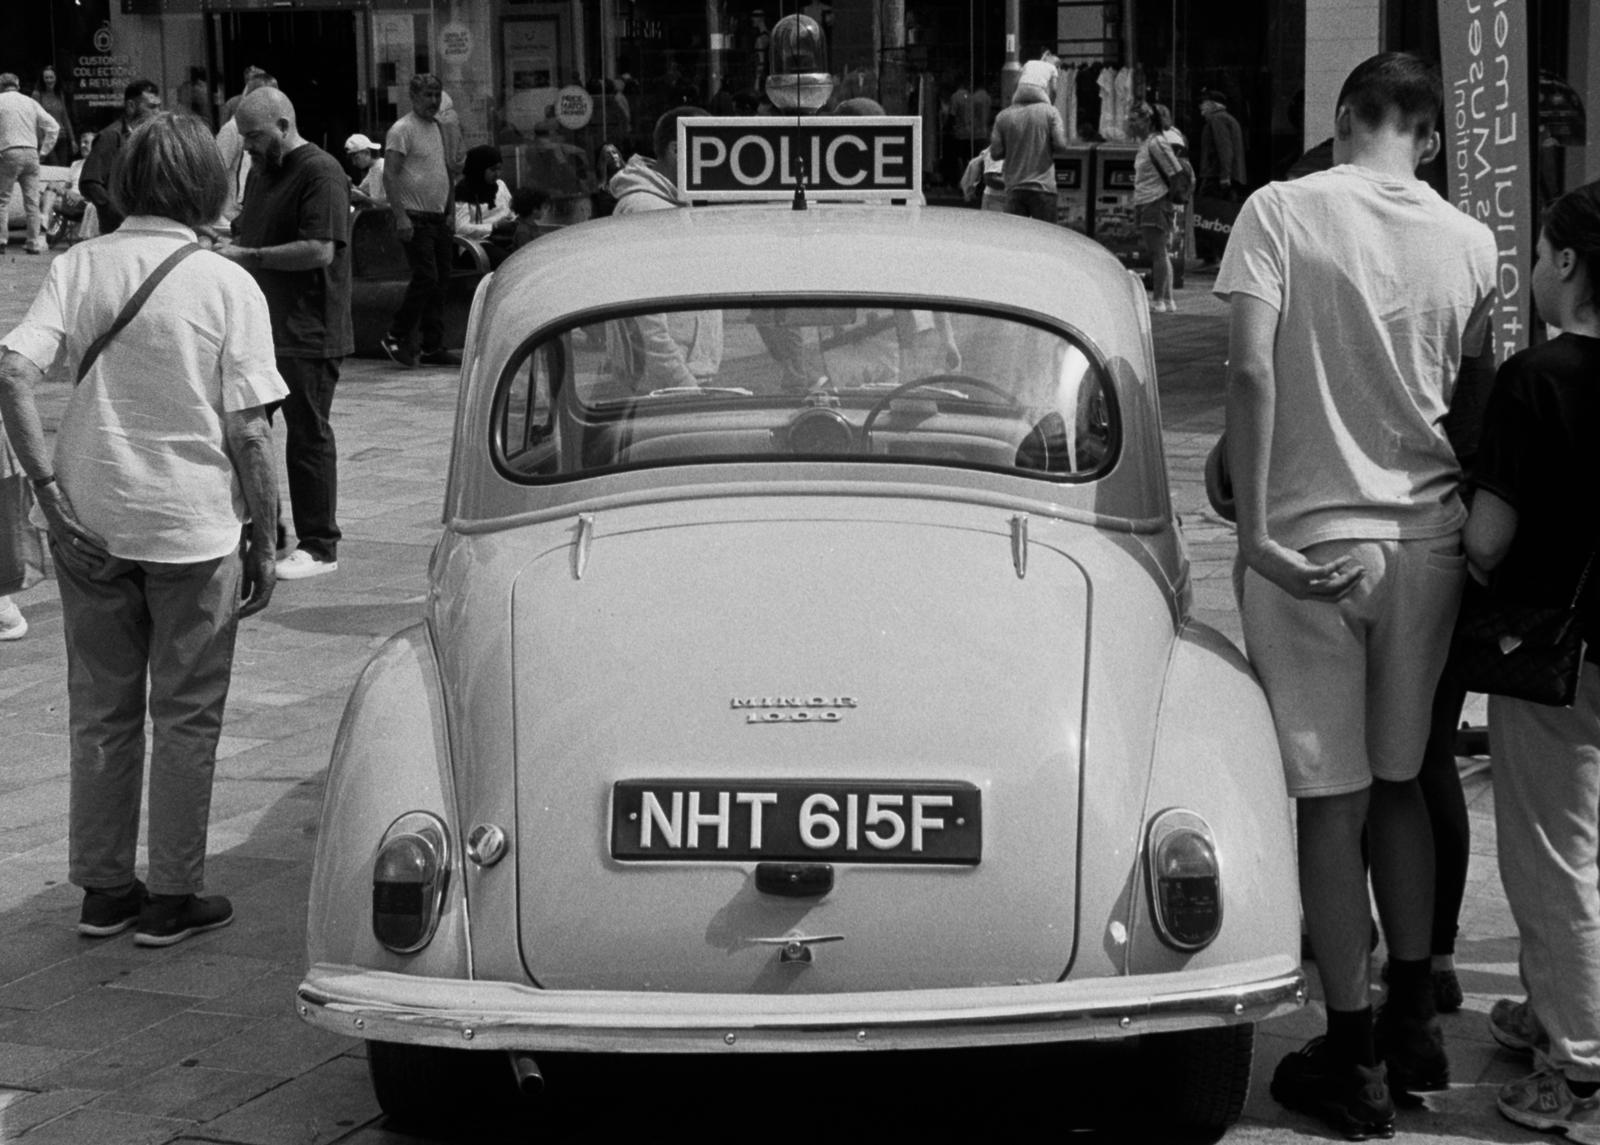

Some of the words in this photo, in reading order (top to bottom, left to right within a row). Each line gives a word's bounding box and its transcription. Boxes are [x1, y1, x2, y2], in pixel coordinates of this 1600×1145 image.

[79, 56, 129, 66] CUSTOMER
[73, 67, 137, 77] COLLECTIONS
[89, 79, 131, 88] RETURNS
[692, 134, 907, 186] POLICE
[1193, 214, 1232, 234] Barbo
[730, 697, 858, 710] MINOR
[745, 712, 843, 725] 1000
[640, 791, 778, 849] NHT
[799, 793, 954, 852] 615F
